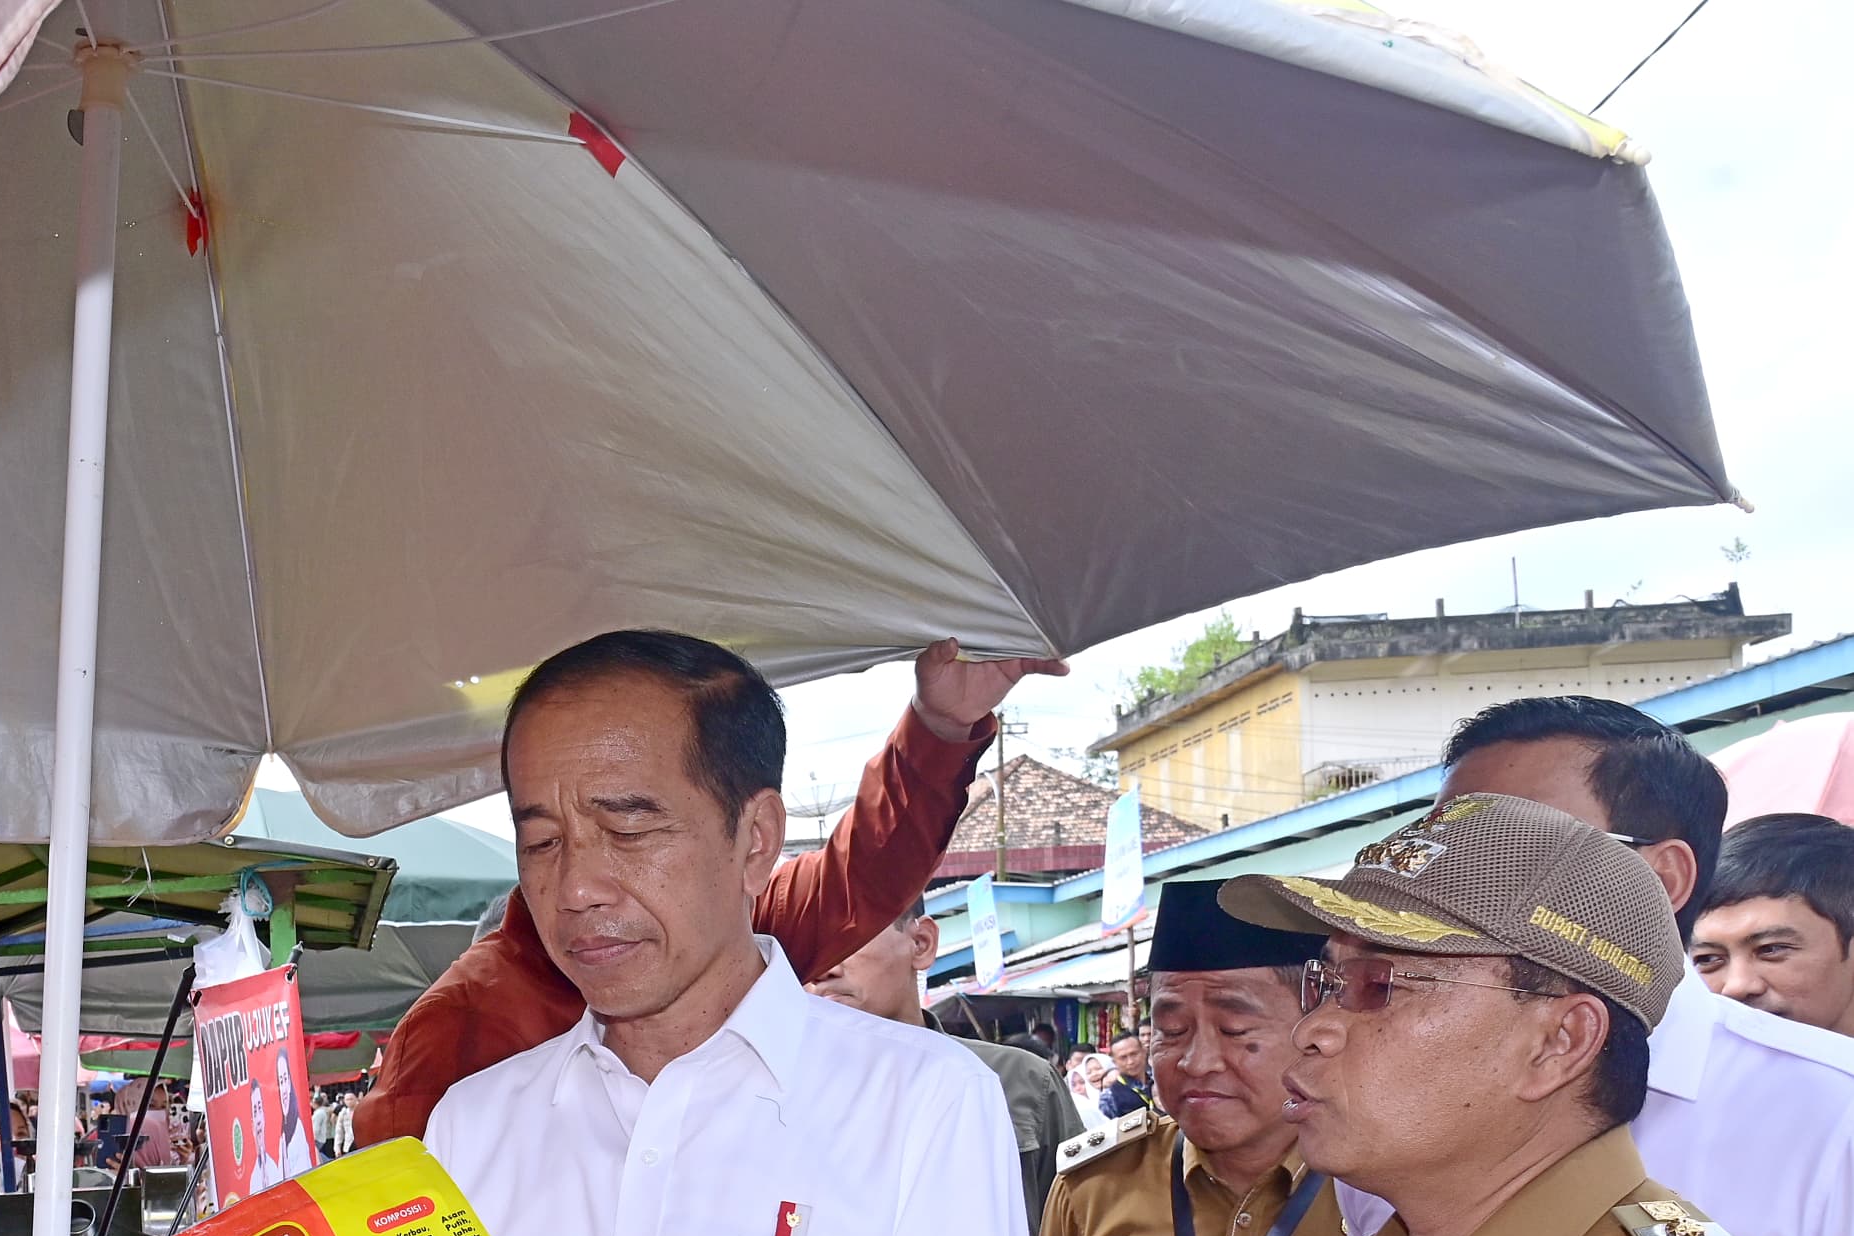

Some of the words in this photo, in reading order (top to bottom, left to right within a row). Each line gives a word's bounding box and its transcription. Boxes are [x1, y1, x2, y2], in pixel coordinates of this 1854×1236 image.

[1530, 905, 1588, 946] BUPATI
[200, 1011, 249, 1102] DAPUR
[243, 1007, 273, 1051] UJUK
[273, 1001, 290, 1041] EF
[374, 1204, 422, 1228] KOMPOSISI
[441, 1209, 466, 1223] Asam
[445, 1218, 471, 1231] Putih,
